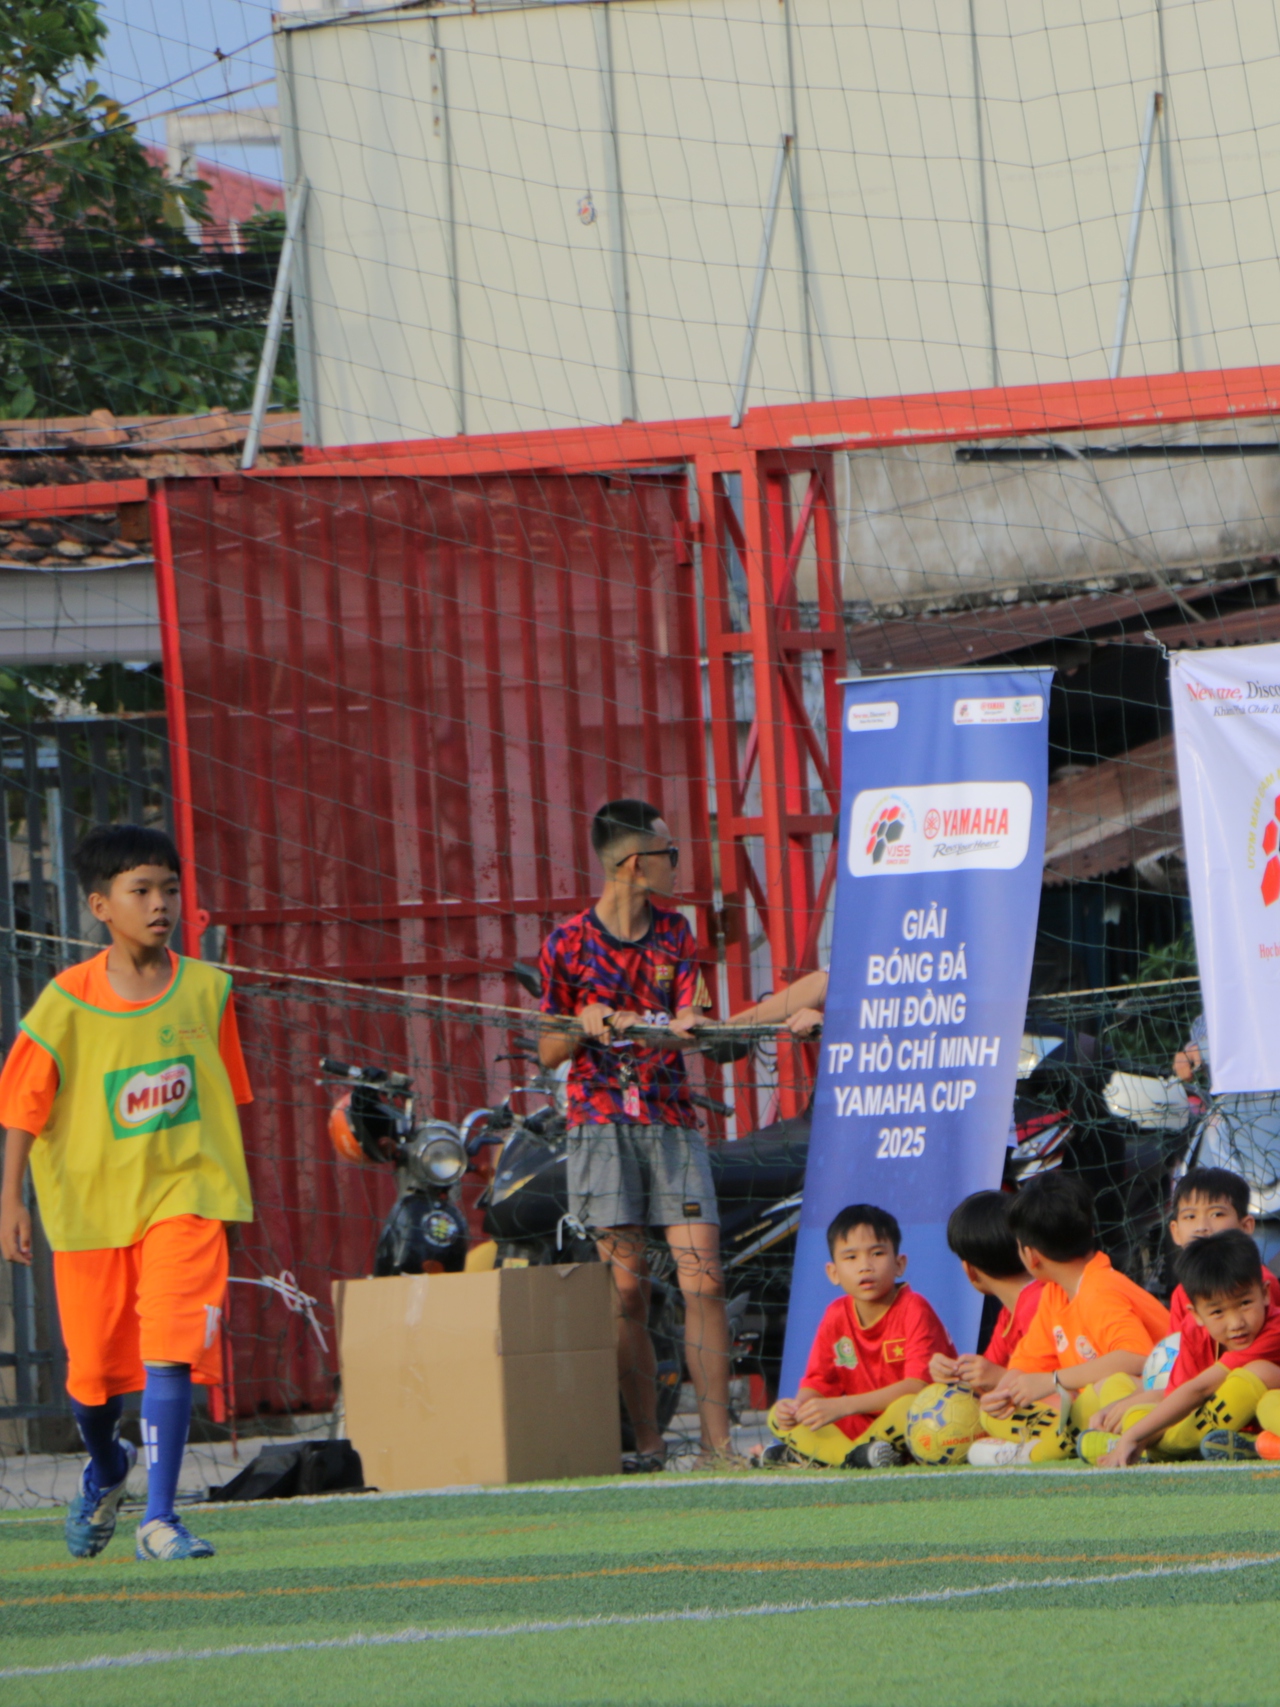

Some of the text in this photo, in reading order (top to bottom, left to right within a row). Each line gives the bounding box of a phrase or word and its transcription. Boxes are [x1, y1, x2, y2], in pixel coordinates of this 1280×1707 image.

[943, 807, 1009, 838] YAMAHA
[903, 902, 948, 941] GIẢI
[867, 942, 968, 986] BÓNG ĐÁ
[860, 988, 967, 1029] NHI ĐỒNG
[828, 1032, 1001, 1074] TP HỒ CHÍ MINH
[127, 1078, 186, 1116] MILO
[834, 1080, 977, 1117] YAMAHA CUP
[876, 1126, 926, 1159] 2025
